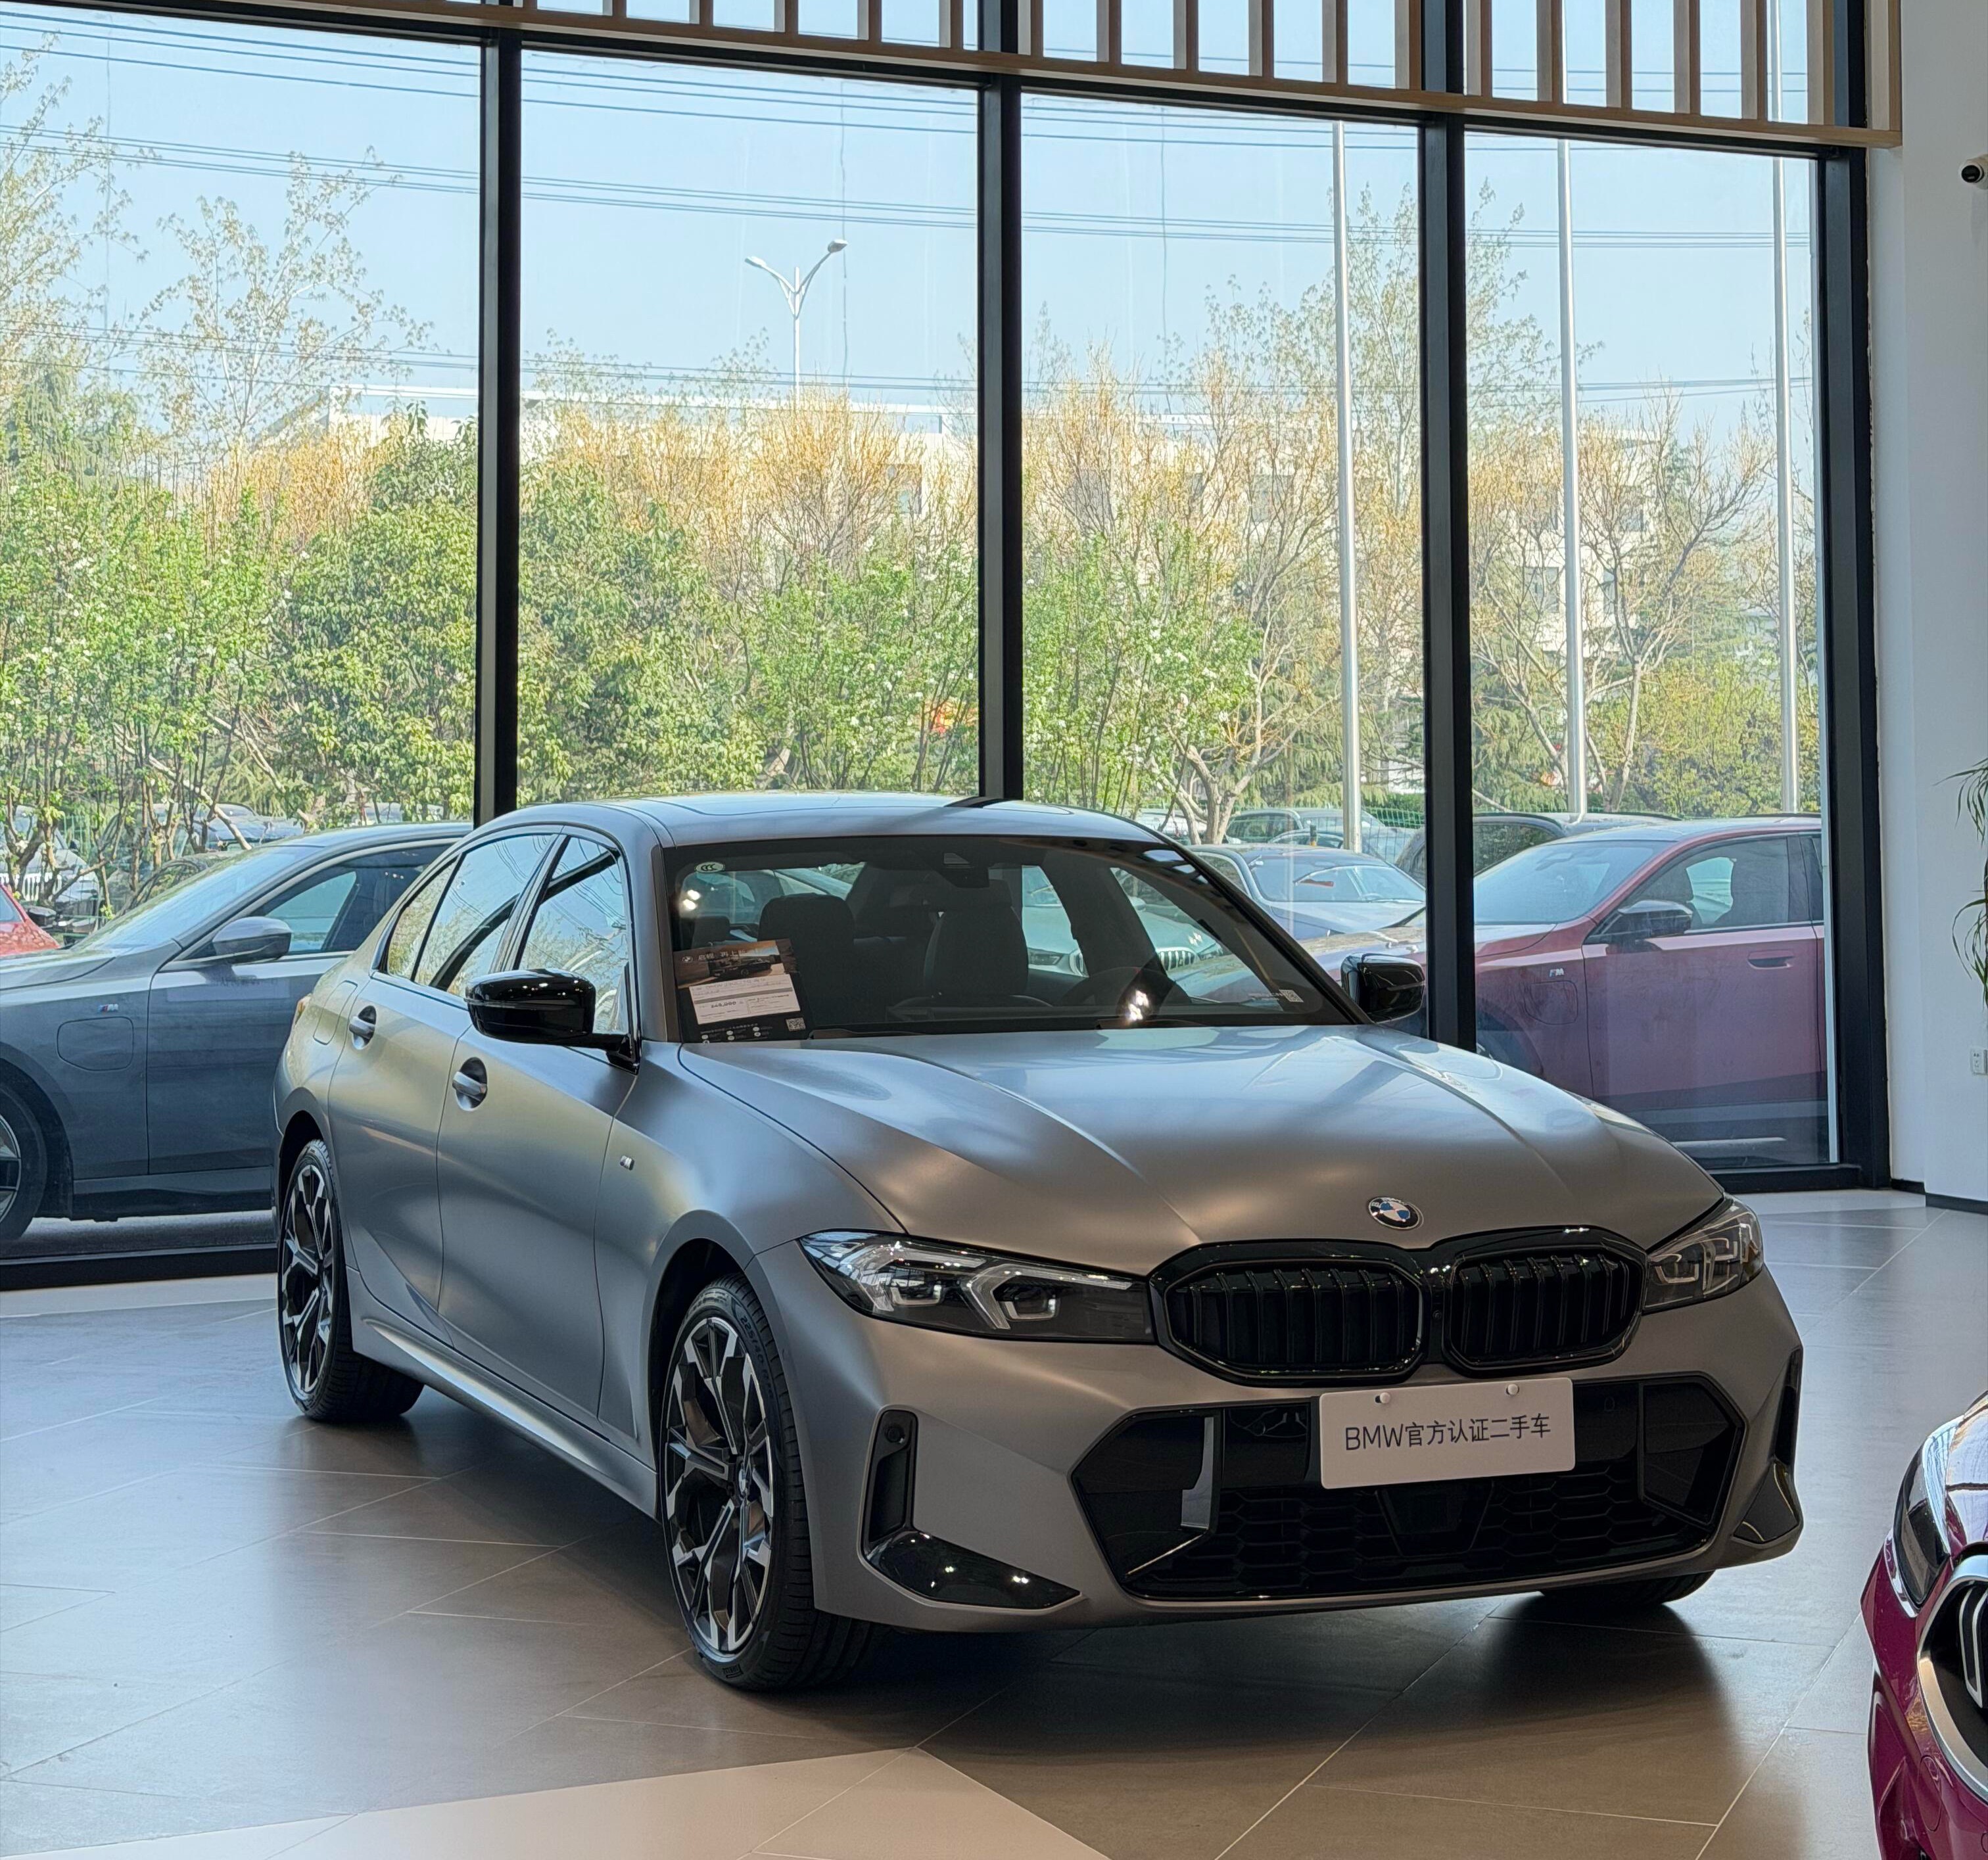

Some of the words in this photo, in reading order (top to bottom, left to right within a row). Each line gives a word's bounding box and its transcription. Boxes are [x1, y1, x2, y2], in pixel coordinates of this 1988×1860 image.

[1345, 1412, 1551, 1451] BMW官方认证二手车
